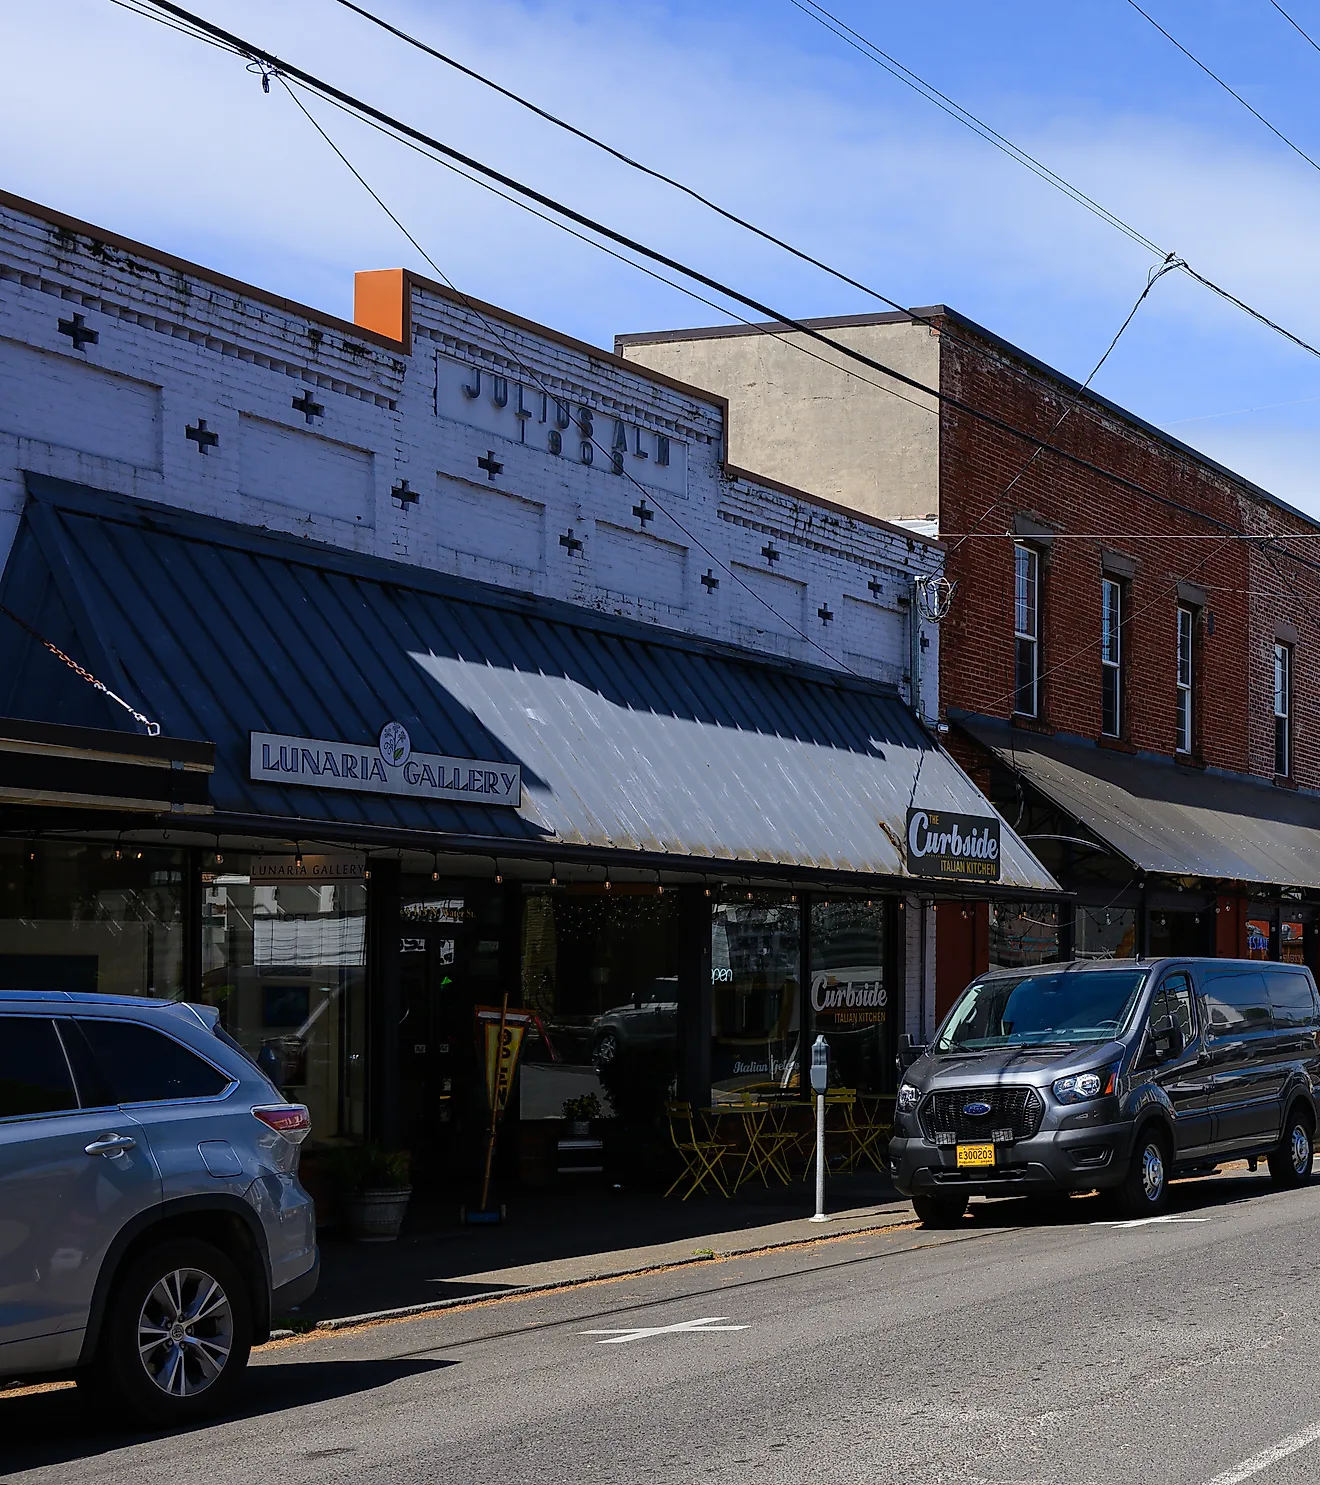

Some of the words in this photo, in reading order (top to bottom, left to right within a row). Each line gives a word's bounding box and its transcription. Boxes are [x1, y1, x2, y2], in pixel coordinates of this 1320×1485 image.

[462, 368, 594, 437] JULIUS
[612, 416, 670, 466] ALM
[520, 419, 624, 474] 1908
[262, 743, 387, 782] LUNARIA
[403, 761, 518, 795] GALLERY
[929, 814, 939, 824] THE
[909, 811, 998, 860] Curbside
[252, 865, 307, 876] LUNARIA
[312, 864, 364, 875] GALLERY
[940, 860, 966, 872] ITALIAN
[966, 862, 996, 876] KITCHEN
[711, 968, 733, 985] pen
[811, 975, 888, 1011] Curbside
[834, 1012, 858, 1024] ITALIAN
[859, 1011, 886, 1022] KITCHEN
[733, 1060, 768, 1073] Italian
[958, 1150, 993, 1160] E300203
